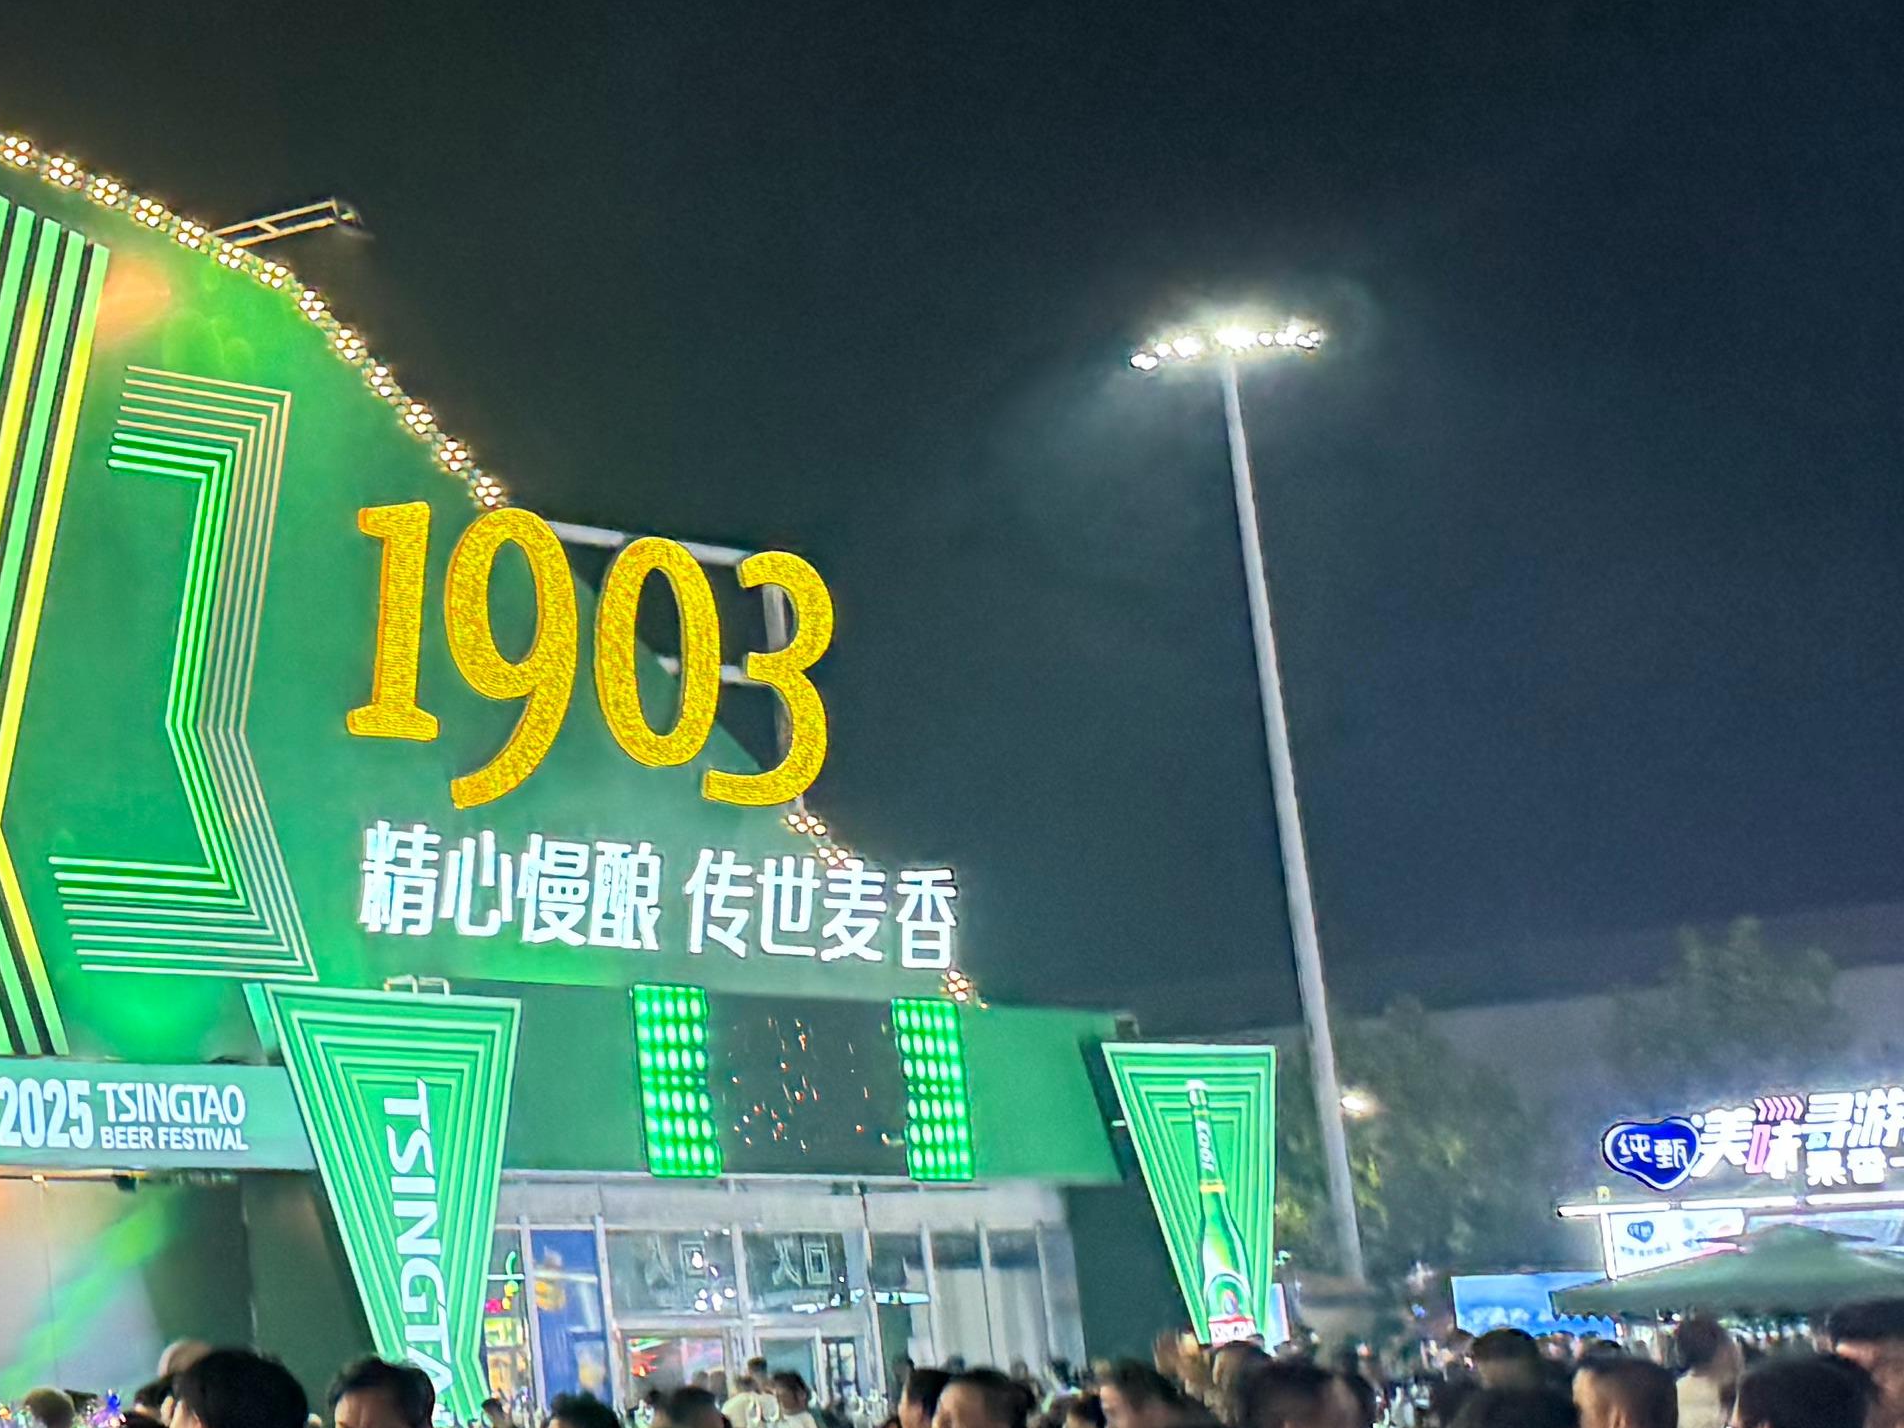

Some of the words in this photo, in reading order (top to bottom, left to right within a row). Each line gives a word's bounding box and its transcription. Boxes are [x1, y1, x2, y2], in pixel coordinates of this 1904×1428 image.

[345, 500, 835, 809] 1903
[359, 819, 662, 952] 精心慢酿
[684, 846, 959, 970] 传世麦香
[96, 1081, 247, 1126] TSINGTAO
[99, 1125, 156, 1150] BEER
[158, 1127, 249, 1152] FESTIVAL
[1617, 1133, 1690, 1171] 纯甄
